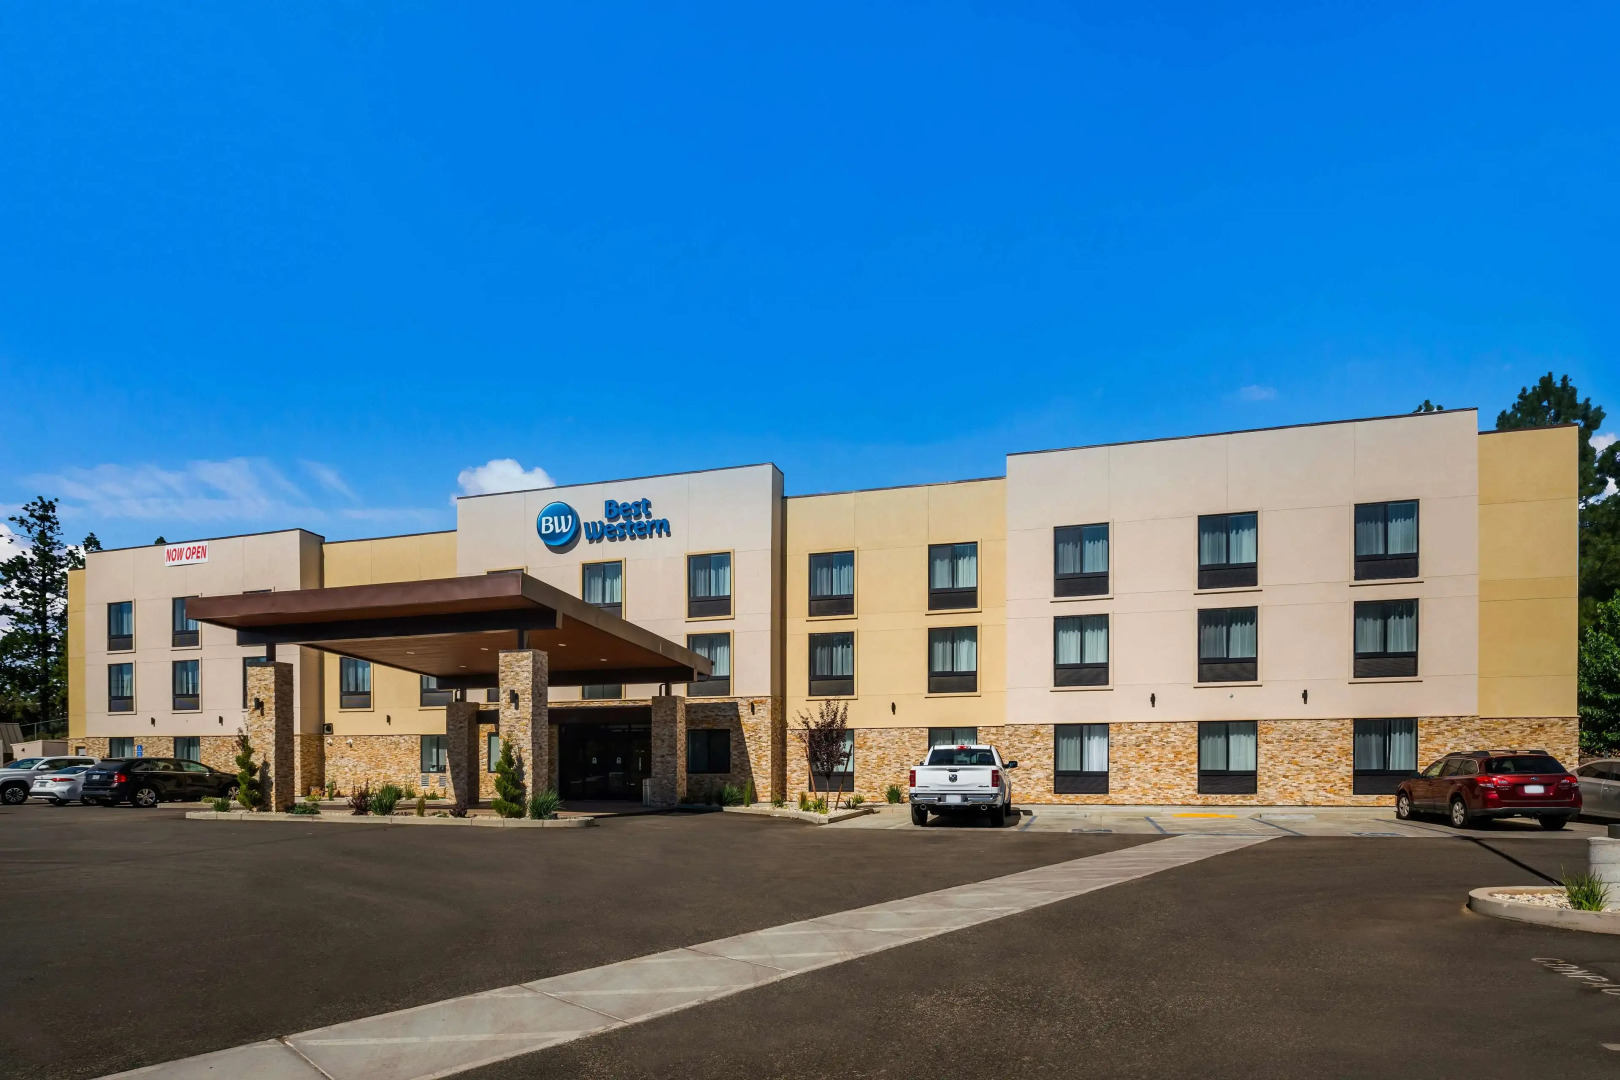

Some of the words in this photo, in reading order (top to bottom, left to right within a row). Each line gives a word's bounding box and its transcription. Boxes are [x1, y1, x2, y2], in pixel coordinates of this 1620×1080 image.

[605, 498, 652, 519] Best
[541, 515, 572, 534] BW
[584, 518, 671, 541] Western
[166, 547, 185, 562] NOW
[185, 545, 207, 560] OPEN
